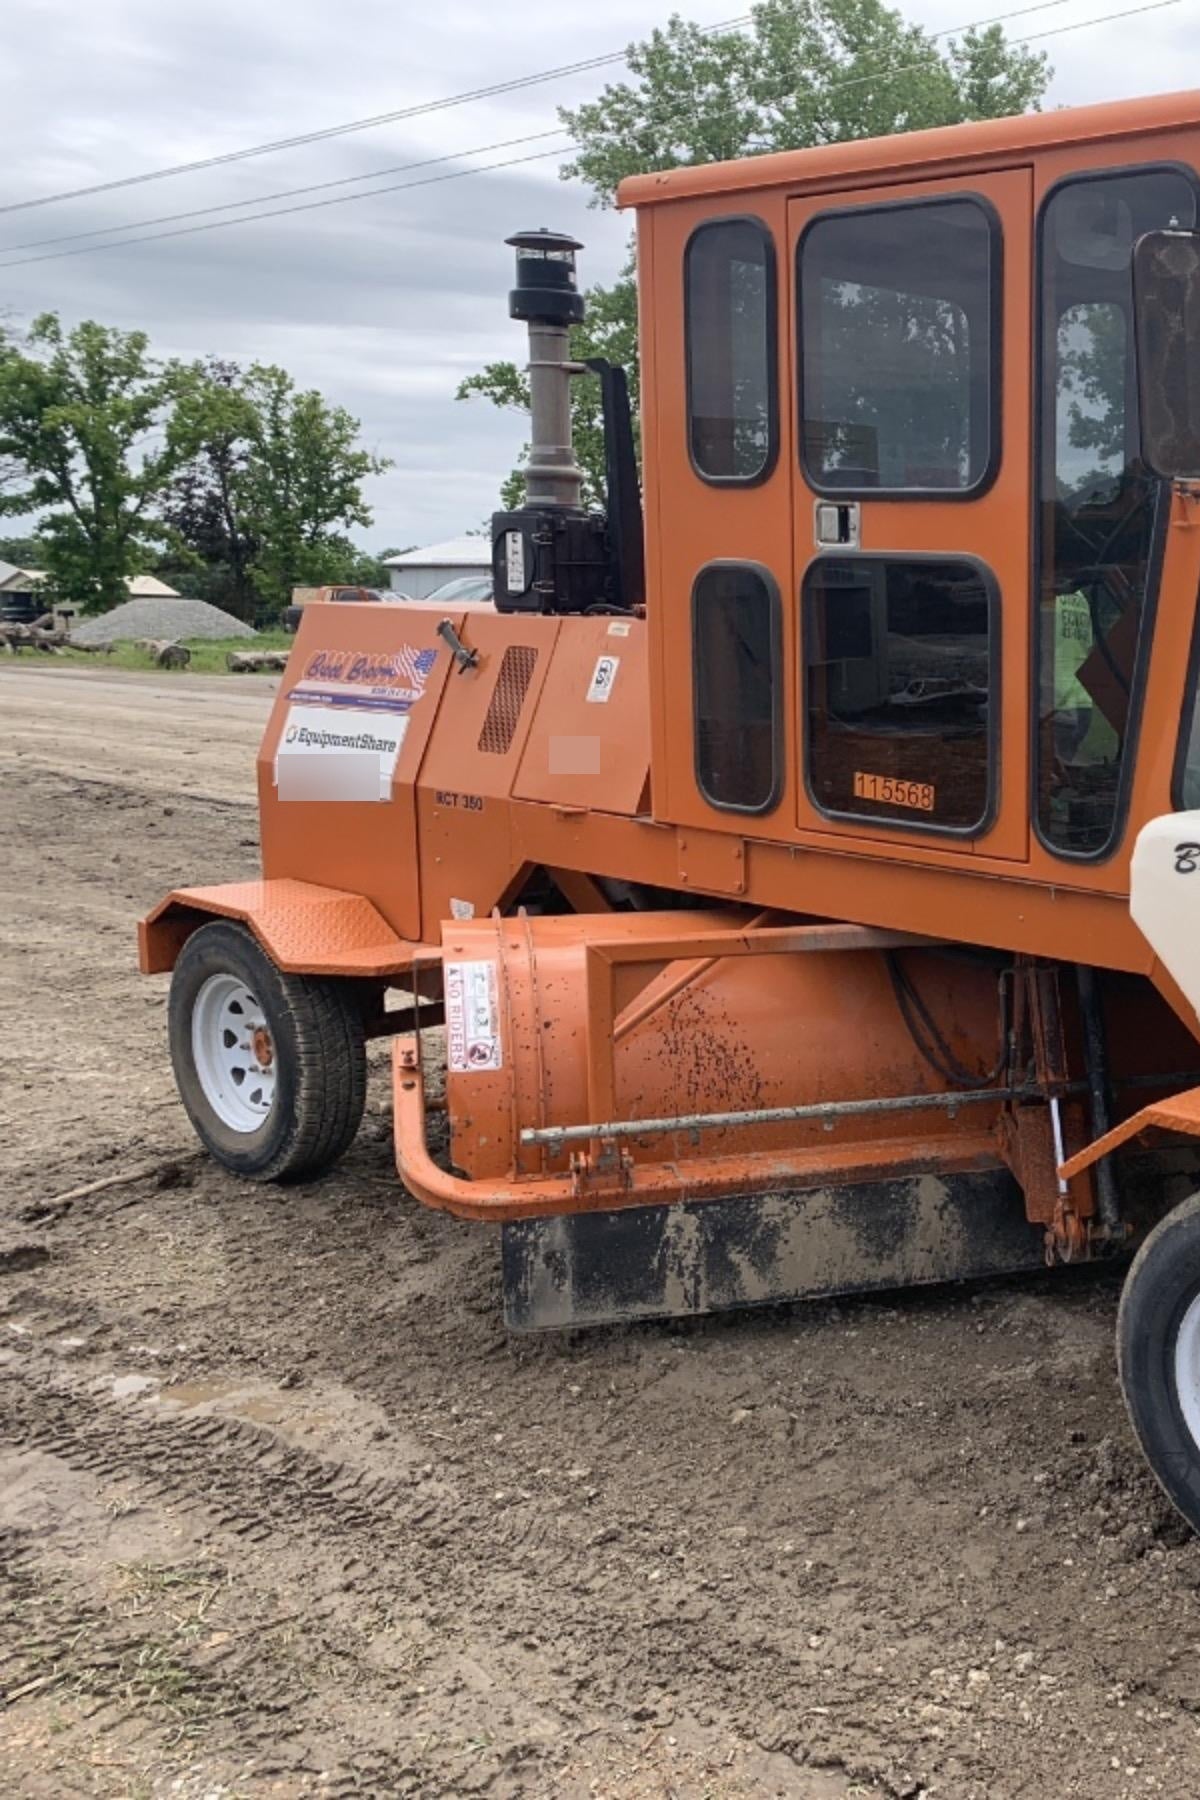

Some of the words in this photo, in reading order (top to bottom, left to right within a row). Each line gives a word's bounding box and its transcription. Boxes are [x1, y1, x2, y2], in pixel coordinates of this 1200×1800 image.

[298, 726, 397, 753] EquipmentShare
[856, 774, 932, 809] 115568
[449, 1005, 464, 1065] RIDERS
